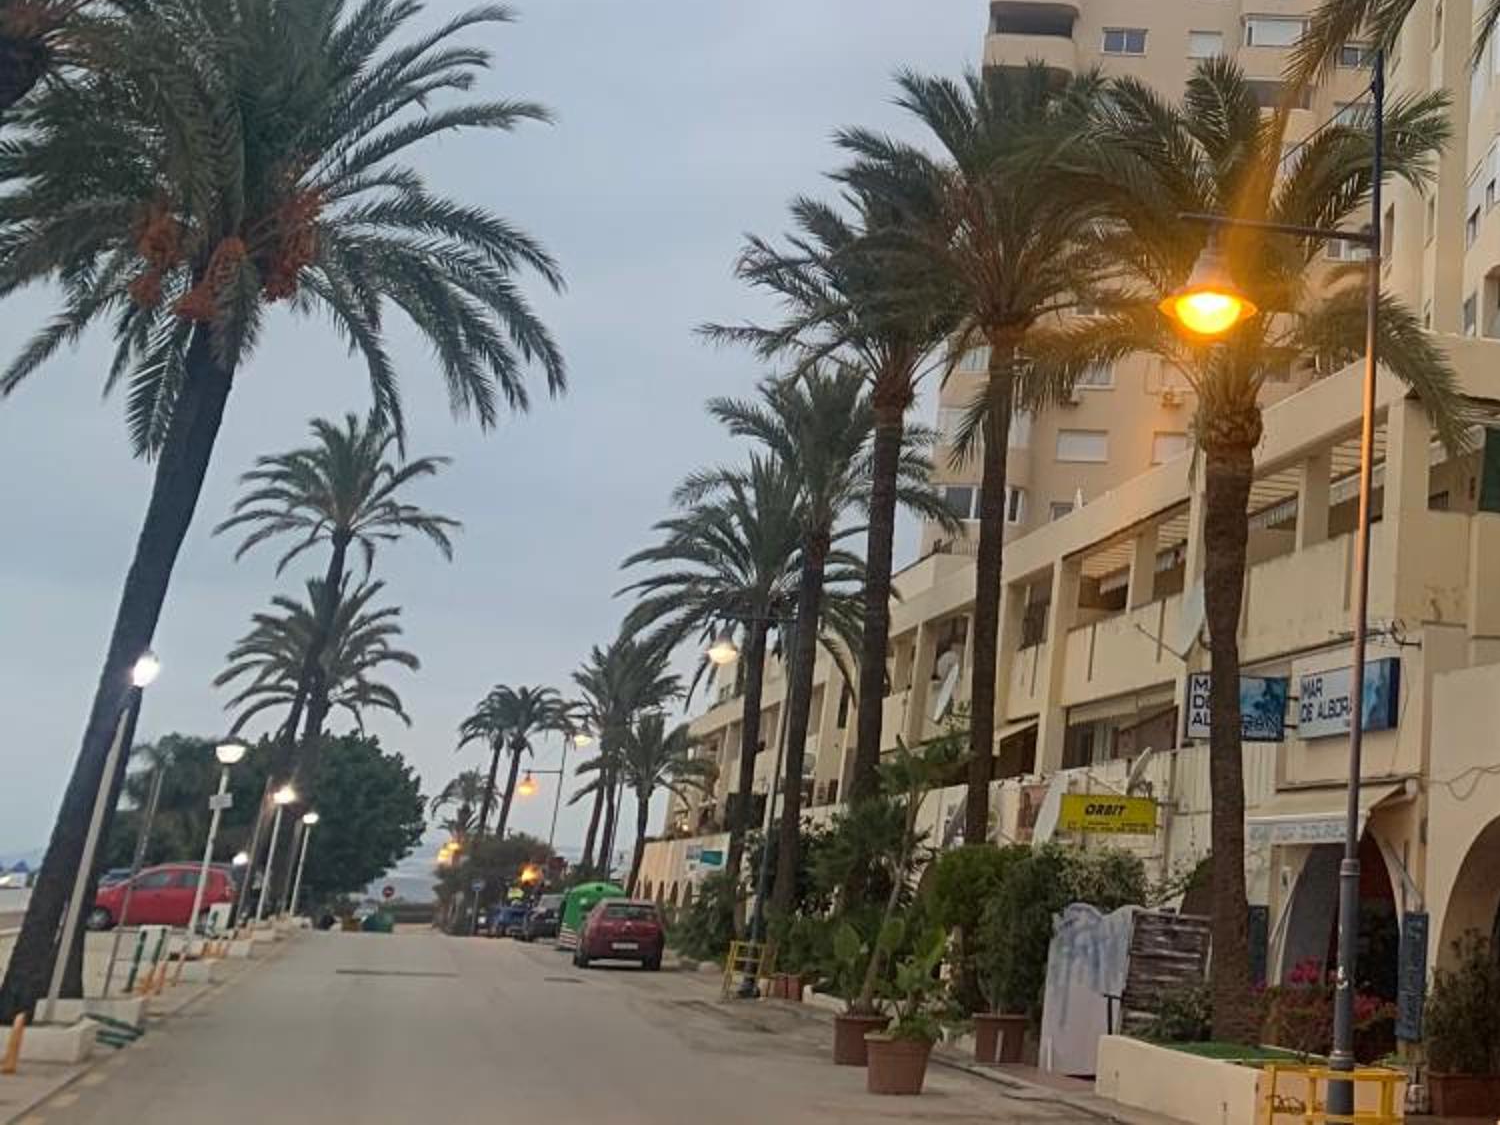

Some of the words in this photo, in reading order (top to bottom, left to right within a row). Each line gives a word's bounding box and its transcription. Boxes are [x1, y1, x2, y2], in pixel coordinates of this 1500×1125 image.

[1300, 678, 1322, 700] MAR
[1300, 702, 1313, 723] DE
[1085, 803, 1126, 816] ORBIT
